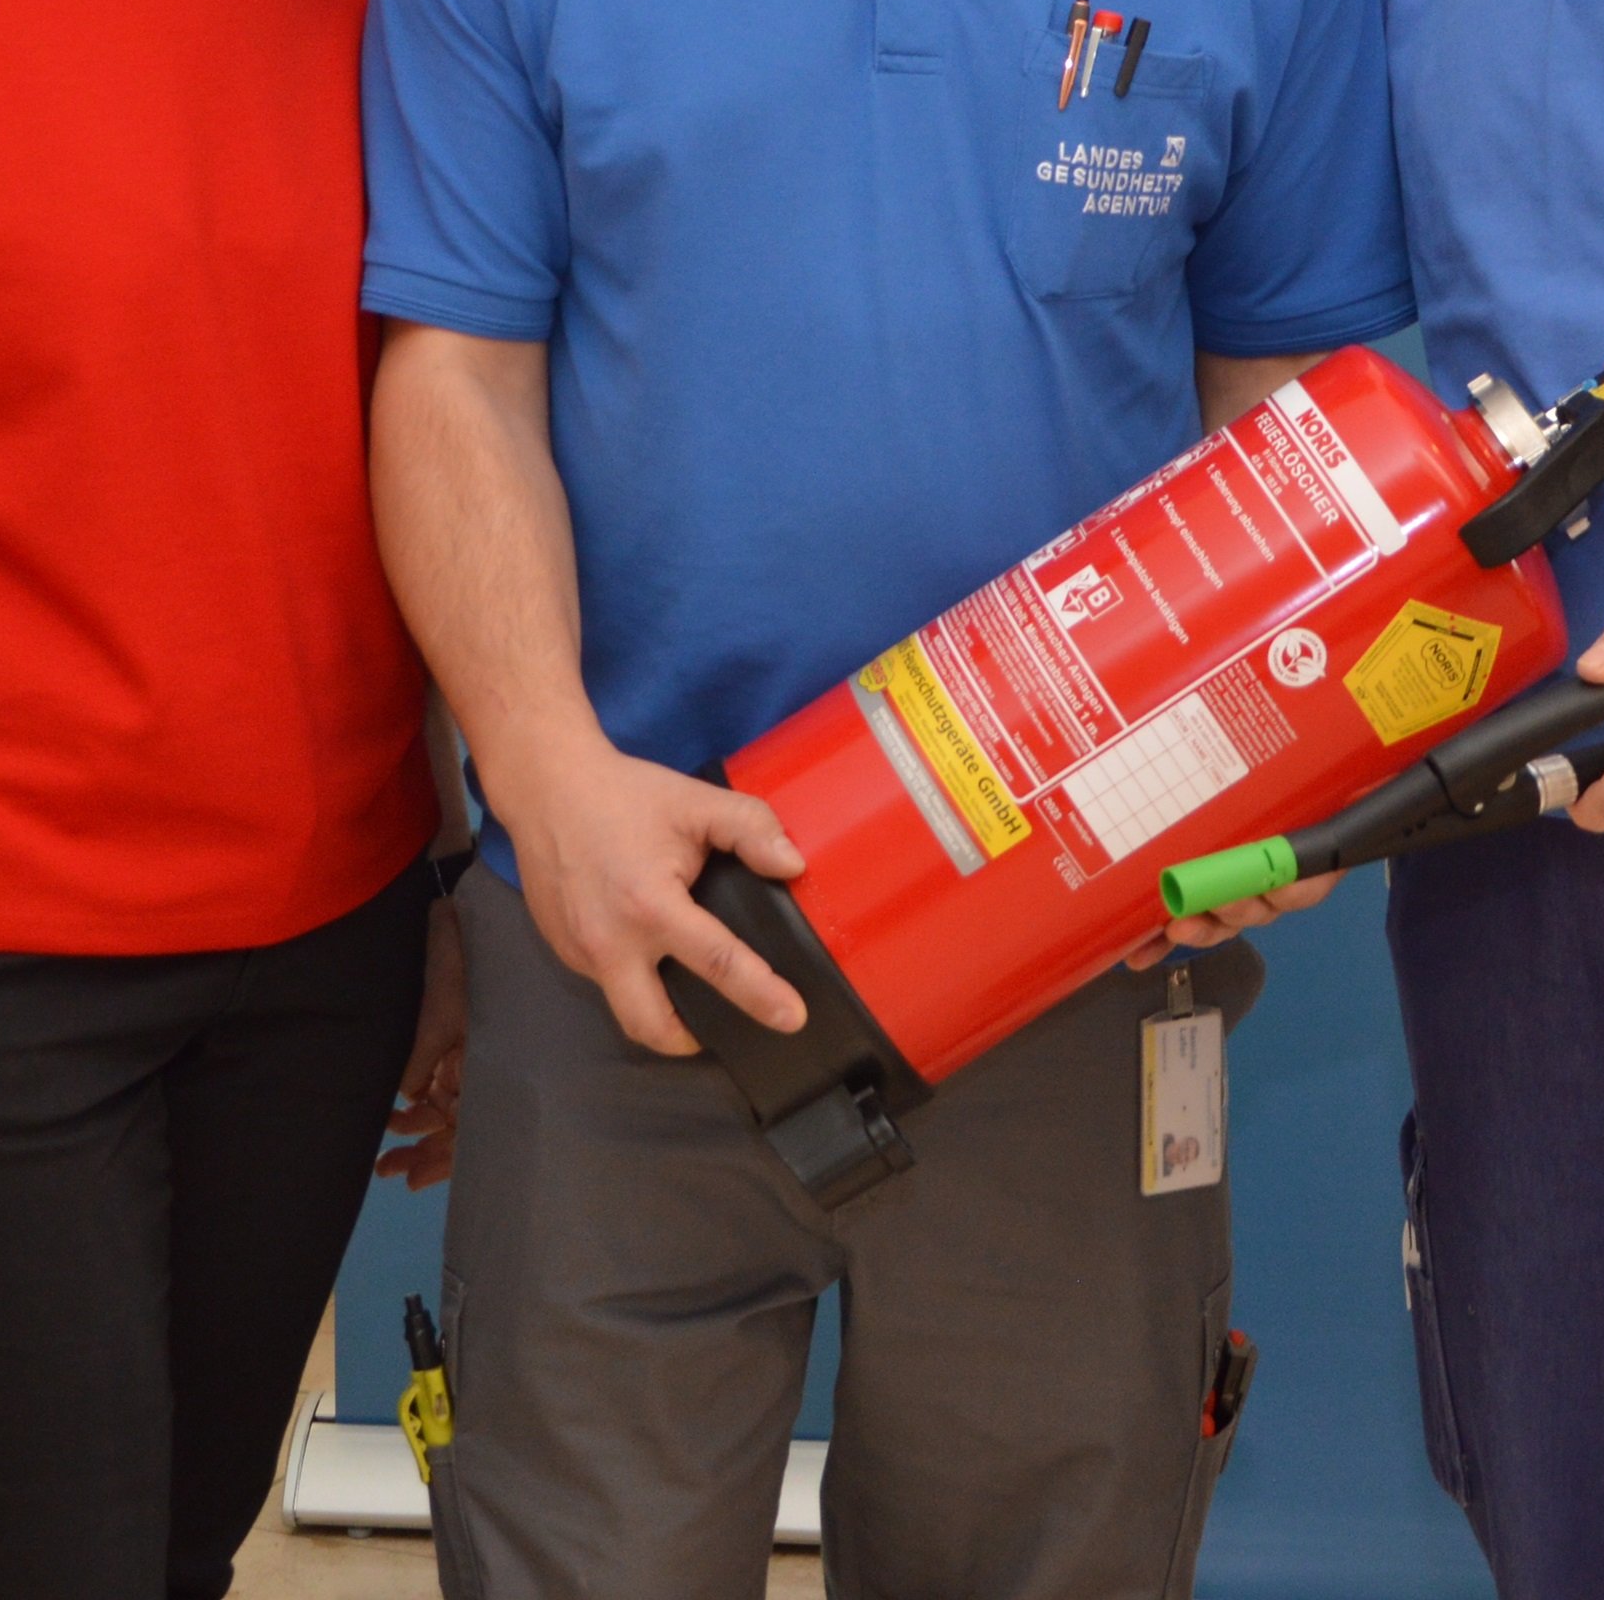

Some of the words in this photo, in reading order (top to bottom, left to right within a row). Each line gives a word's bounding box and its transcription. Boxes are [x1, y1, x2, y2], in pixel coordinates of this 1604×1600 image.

[1058, 141, 1144, 169] LANDES
[1082, 193, 1171, 217] AGENTUR
[1253, 410, 1340, 526] FEUERLÖSCHER
[1294, 408, 1347, 470] NORIS
[1266, 455, 1291, 486] Schaum
[1160, 500, 1185, 530] Knopf
[1178, 525, 1226, 591] einschlagen
[1208, 469, 1244, 516] Sicherung
[1237, 511, 1277, 563] abziehen
[1055, 533, 1078, 553] A
[1085, 584, 1113, 610] B
[1112, 533, 1156, 593] Löschpistole
[1148, 588, 1192, 647] betätigen
[1020, 587, 1036, 604] bei
[1028, 601, 1074, 667] elektrischen
[1066, 662, 1105, 716] Anlagen
[1022, 622, 1085, 711] Mindestabstand
[1427, 642, 1459, 682] NORIS
[900, 648, 983, 775] Feuerschutzgeräte
[974, 774, 1023, 835] GmbH
[977, 712, 1001, 743] GmbH
[1079, 710, 1090, 720] 1
[1084, 720, 1101, 740] m.
[1041, 795, 1064, 821] 2023
